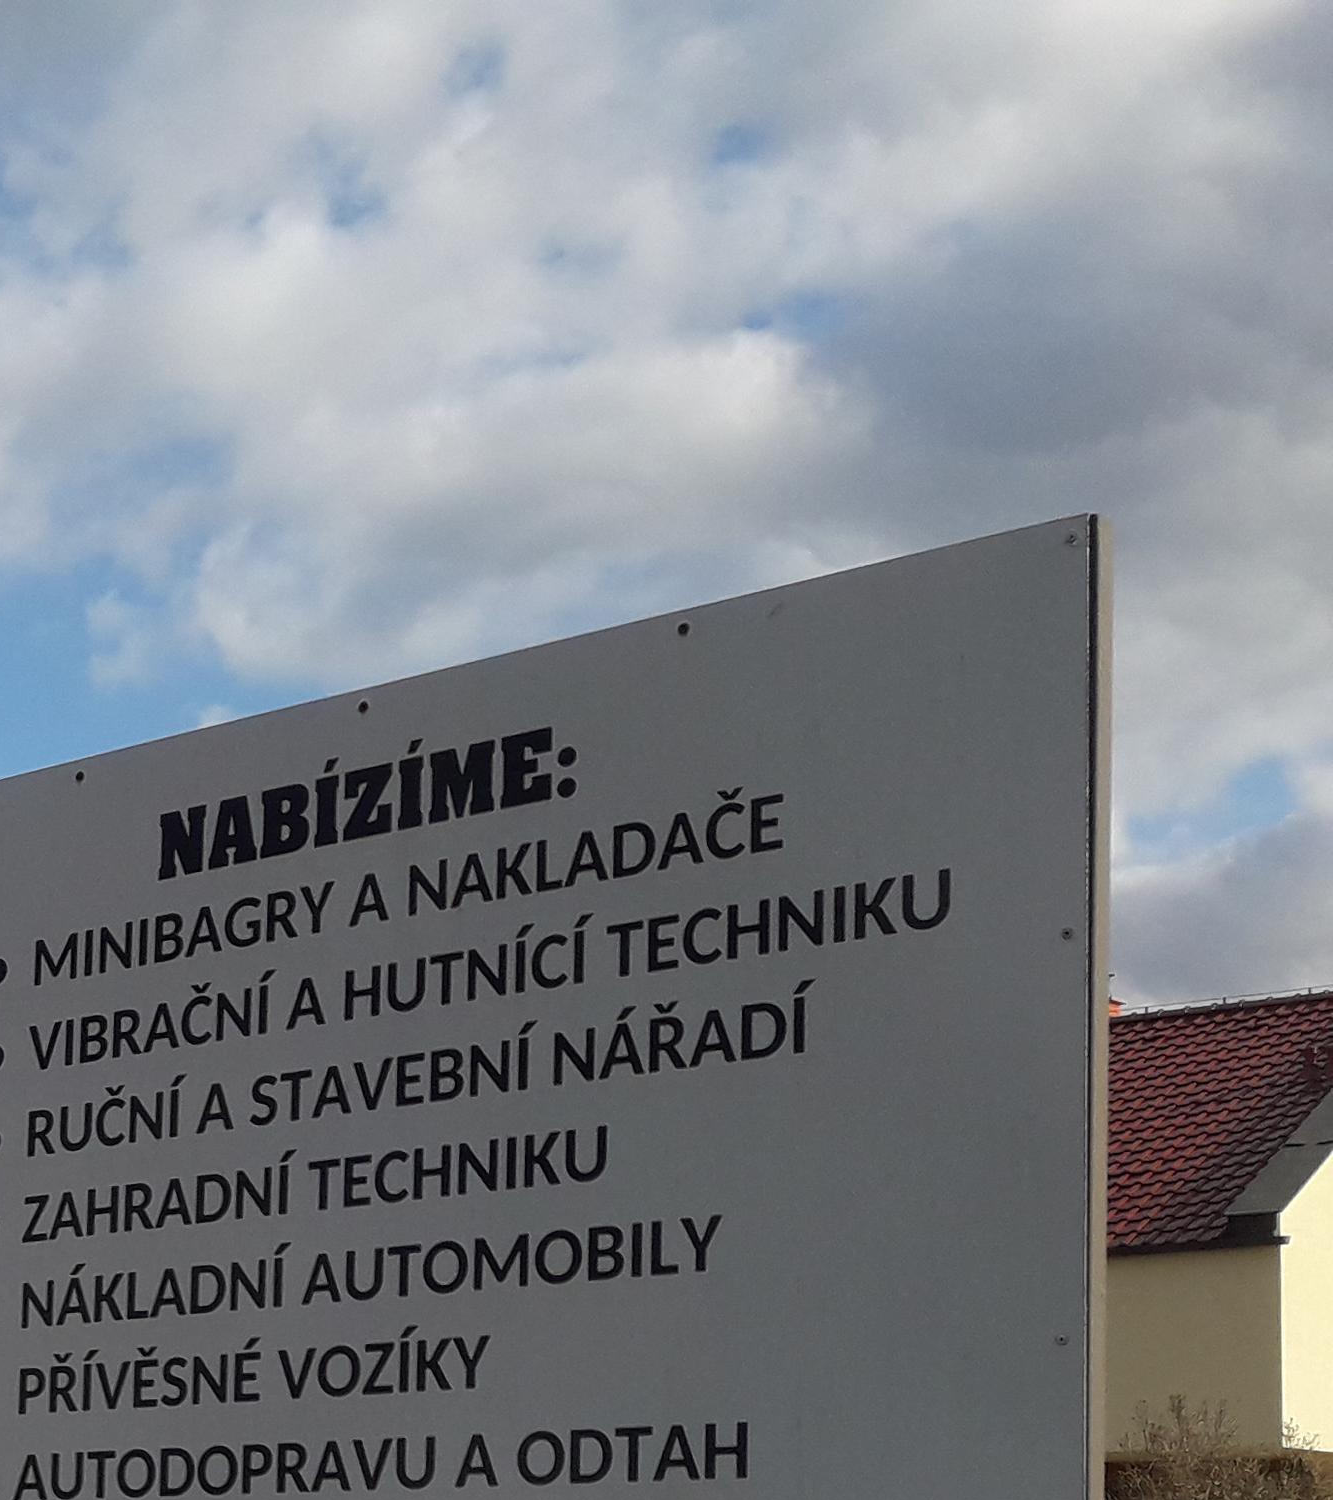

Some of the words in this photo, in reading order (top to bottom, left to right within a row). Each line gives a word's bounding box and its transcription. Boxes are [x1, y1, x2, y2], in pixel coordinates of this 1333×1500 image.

[157, 725, 578, 882] NABÍZÍME:
[33, 880, 336, 987] MINIBAGRY
[347, 872, 390, 929] A
[407, 786, 785, 918] NAKLADAČE
[28, 968, 278, 1071] VIBRAČNÍ
[285, 976, 327, 1032] A
[342, 911, 595, 1022] HUTNÍCÍ
[605, 867, 952, 978] TECHNIKU
[26, 1072, 188, 1159] RUČNÍ
[194, 1082, 235, 1135] A
[248, 1019, 539, 1127] STAVEBNÍ
[552, 978, 817, 1087] NÁŘADÍ
[21, 1148, 298, 1244] ZAHRADNÍ
[306, 1124, 609, 1212] TECHNIKU
[20, 1241, 292, 1330] NÁKLADNÍ
[300, 1213, 723, 1307] AUTOMOBILY
[17, 1336, 262, 1416] PŘÍVĚSNÉ
[276, 1323, 492, 1400] VOZÍKY
[454, 1433, 500, 1489] A
[516, 1421, 749, 1487] ODTAH
